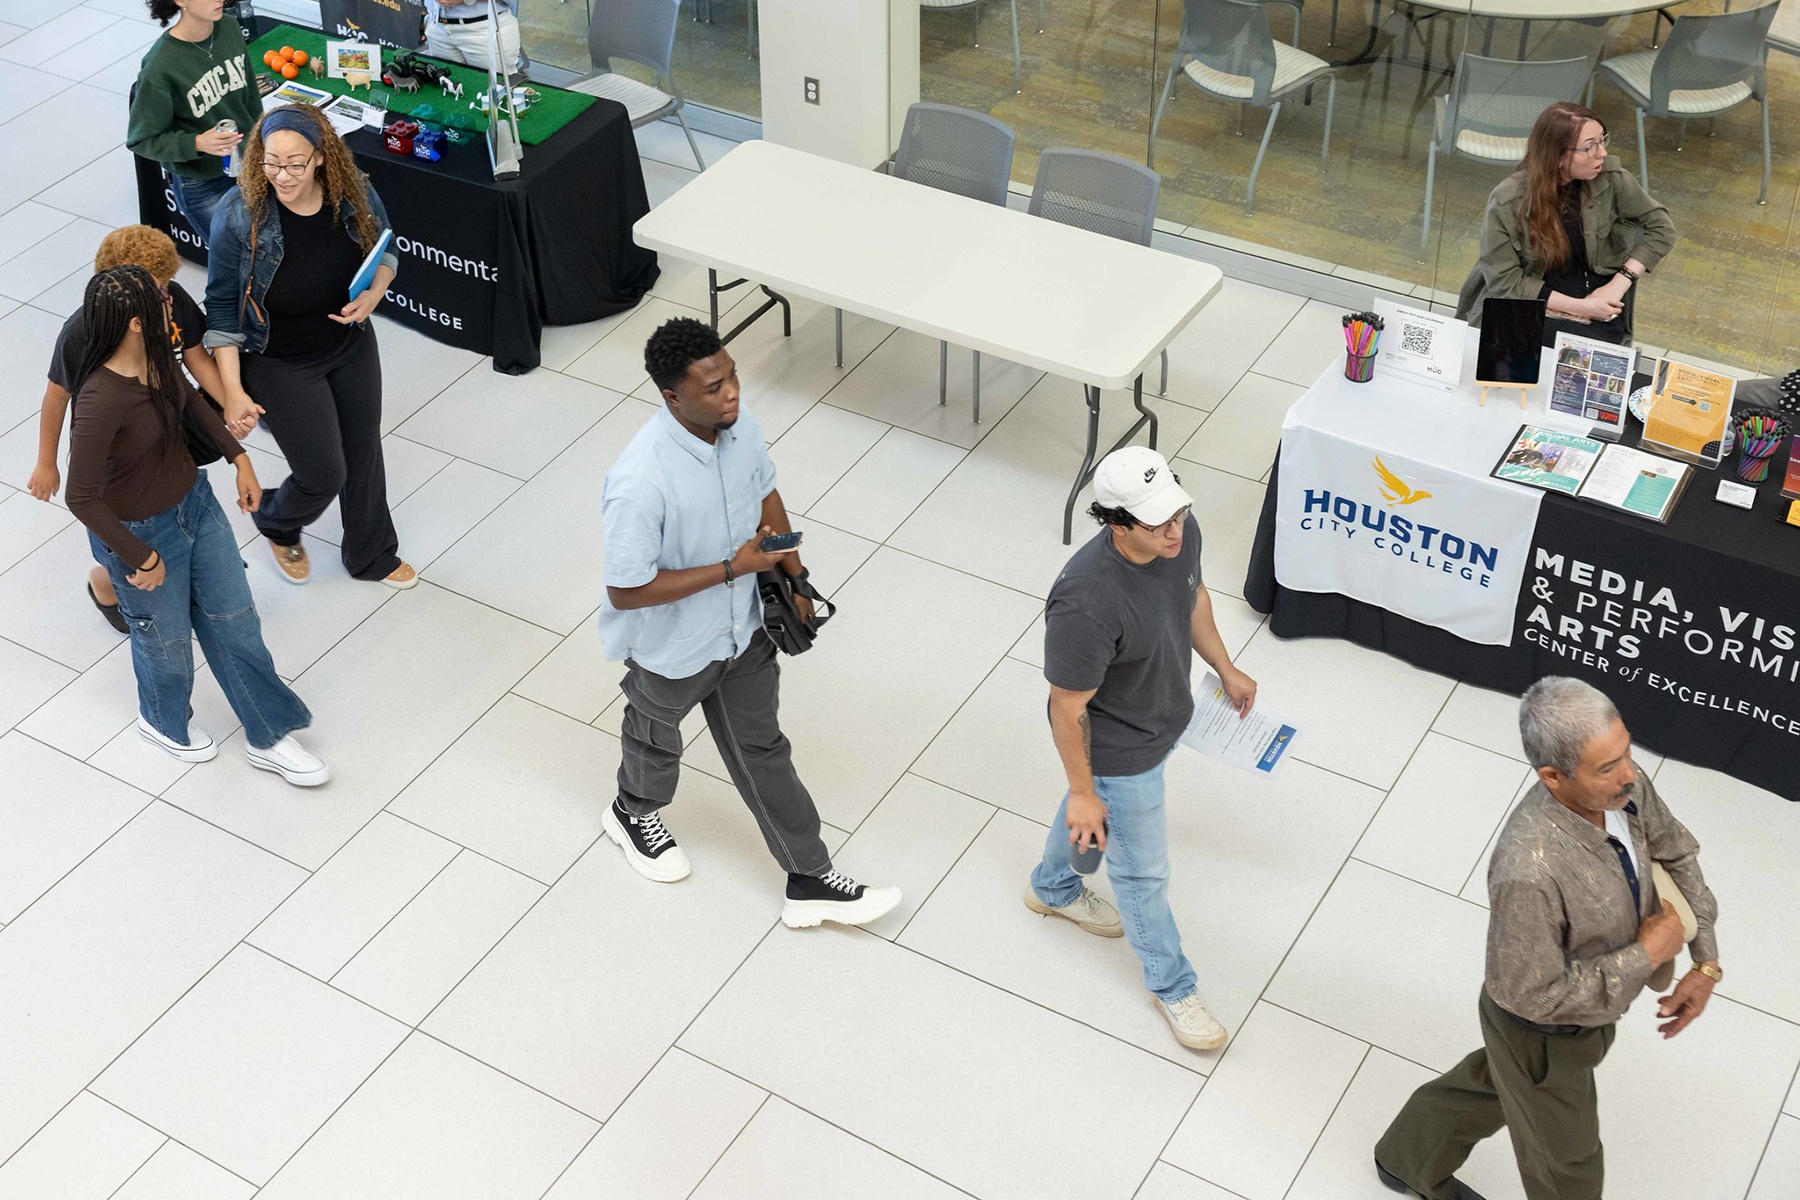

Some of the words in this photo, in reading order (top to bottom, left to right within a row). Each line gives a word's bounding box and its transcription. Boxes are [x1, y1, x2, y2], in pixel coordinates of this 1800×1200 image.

[384, 289, 463, 331] COLLEGE
[1300, 517, 1356, 539] CITY
[1374, 537, 1490, 588] COLLEGE
[1303, 489, 1499, 572] HOUSTON
[1526, 604, 1641, 659] ARTS
[1531, 576, 1554, 604] &
[1576, 591, 1800, 683] PERFORMI
[1534, 547, 1694, 623] MEDIA,
[1719, 606, 1797, 650] VIS
[1523, 628, 1610, 673] CENTER
[1619, 666, 1643, 682] of
[1648, 672, 1800, 736] EXCELLENCE
